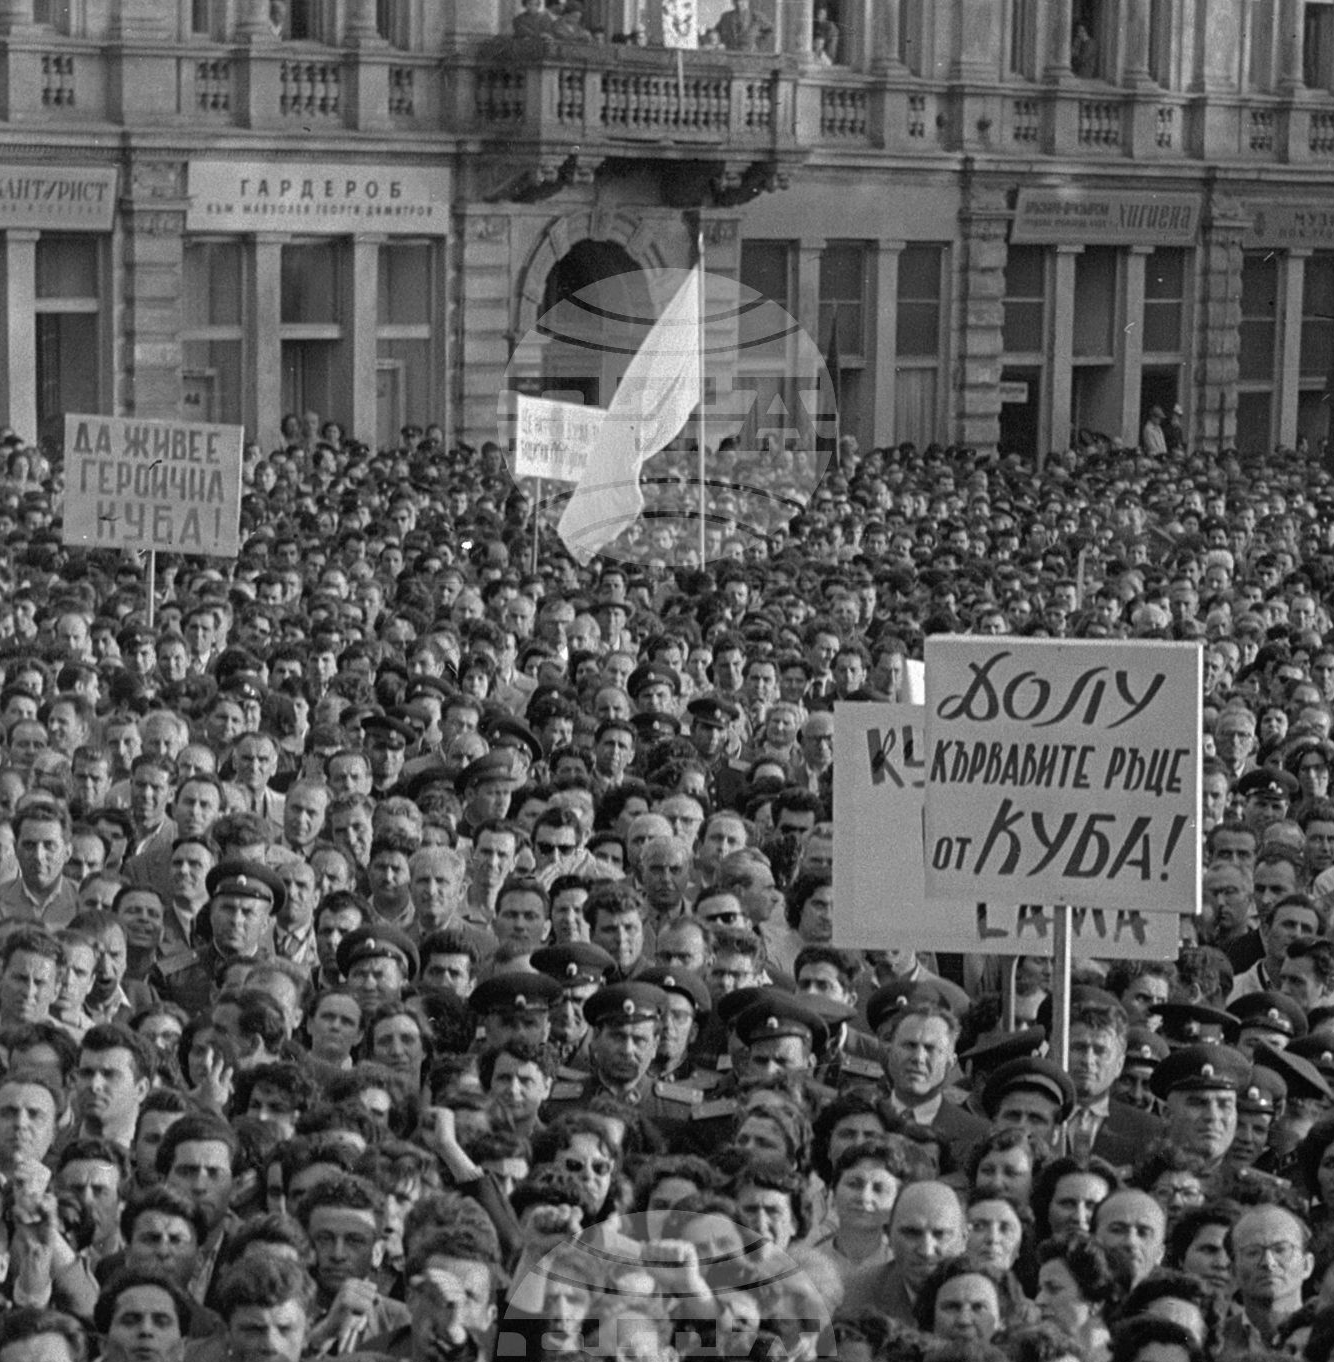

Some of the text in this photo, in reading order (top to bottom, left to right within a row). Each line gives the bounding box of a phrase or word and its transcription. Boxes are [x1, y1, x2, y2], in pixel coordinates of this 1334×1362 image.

[240, 179, 402, 199] ГАРДЕРОБ
[73, 422, 221, 464] ДА ЖИВЕЕ
[81, 458, 224, 503] ГЕРОИЧНА
[937, 650, 1166, 729] ДОЛУ
[930, 739, 1190, 796] КЪРВАВИТЕ РЪЦЕ
[974, 798, 1190, 882] КУБА!
